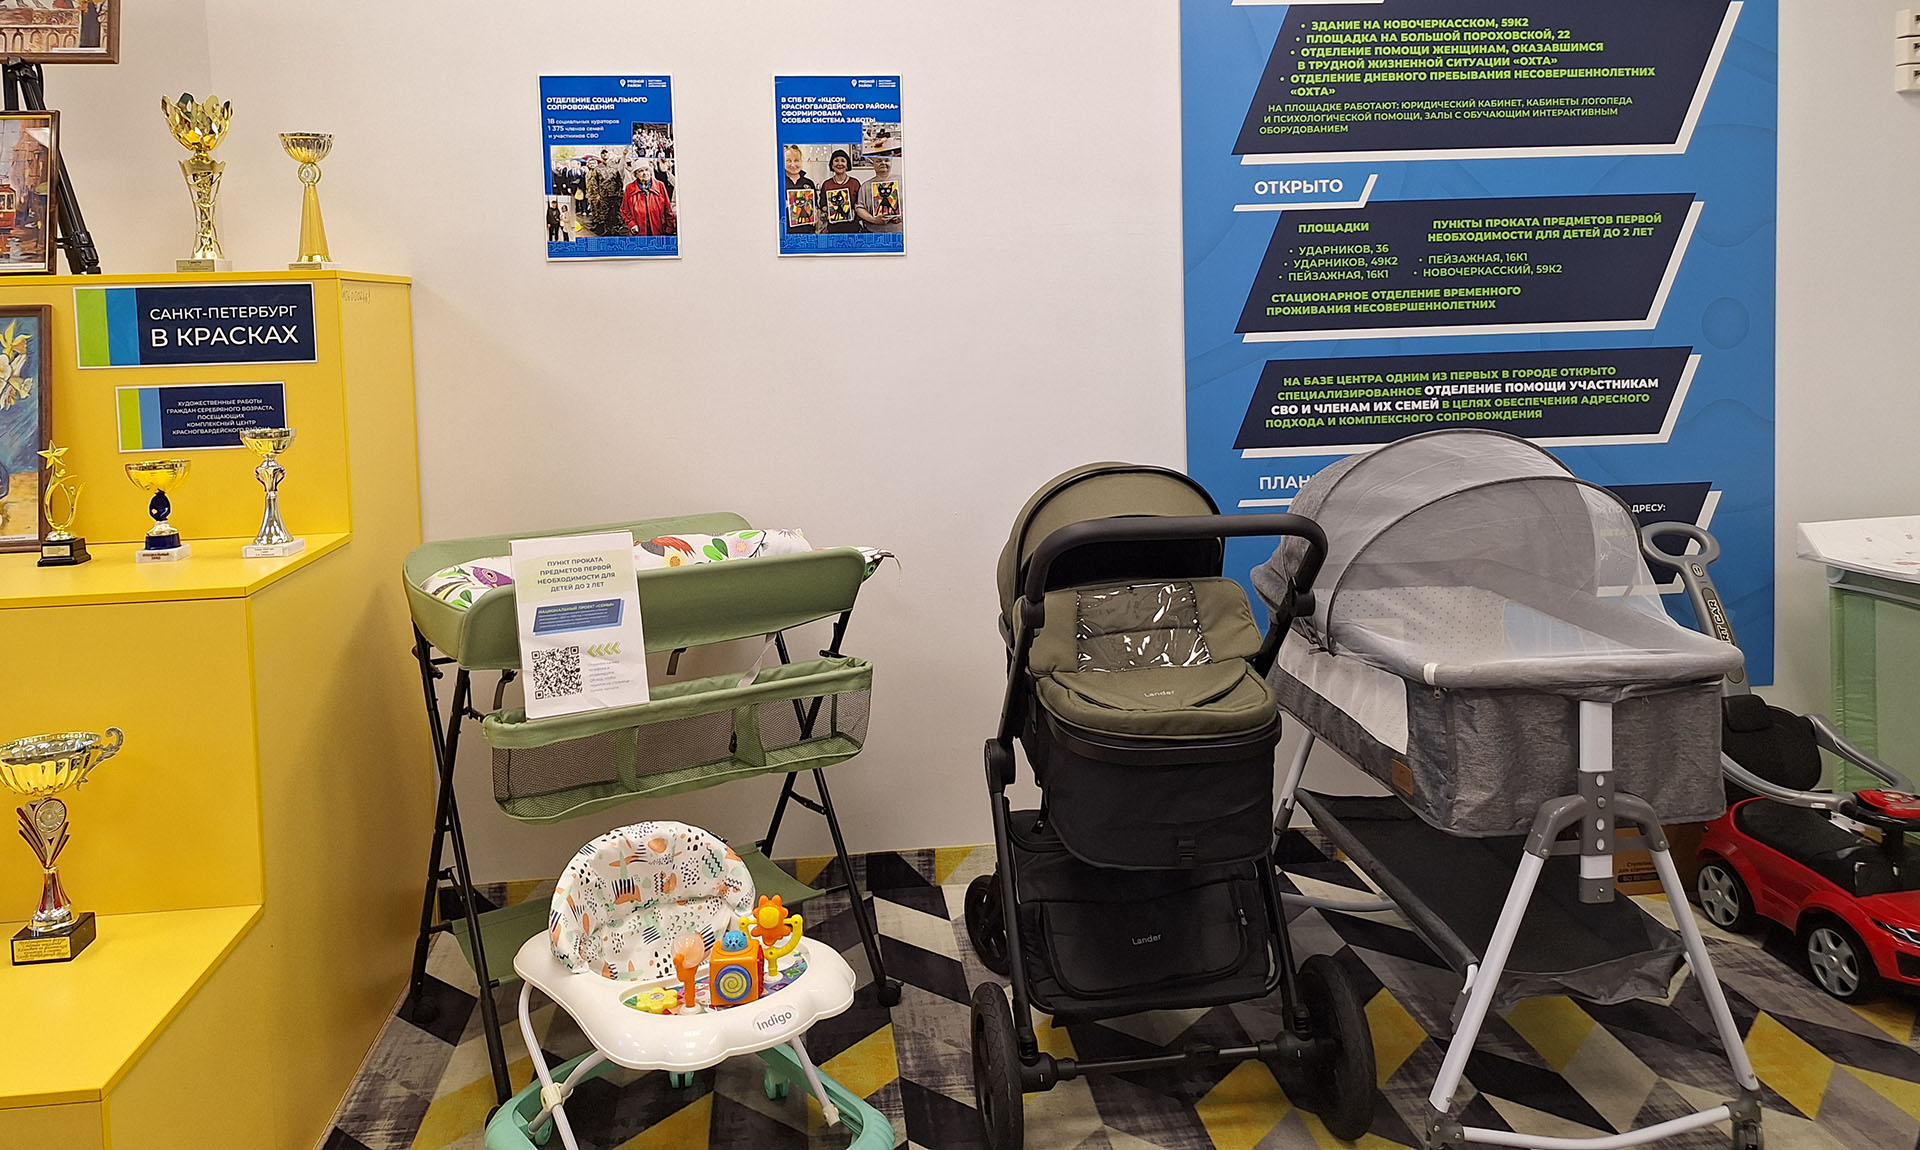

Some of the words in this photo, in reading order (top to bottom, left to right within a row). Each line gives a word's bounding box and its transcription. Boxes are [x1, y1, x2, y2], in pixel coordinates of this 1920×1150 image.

[1311, 21, 1360, 31] ЗДАНИЕ
[1363, 21, 1380, 30] НА
[1383, 19, 1498, 29] НОВОЧЕРКАССКОМ,
[1501, 18, 1529, 27] 59К2
[1306, 33, 1377, 44] ПЛОЩАДКА
[1381, 33, 1398, 42] НА
[1400, 31, 1460, 42] БОЛЬШОЙ
[1464, 28, 1555, 42] ПОРОХОВСКОЙ,
[1557, 30, 1570, 39] 22
[1301, 46, 1371, 57] ОТДЕЛЕНИЕ
[1374, 45, 1429, 56] ПОМОЩИ
[1432, 44, 1509, 55] ЖЕНЩИНАМ,
[1512, 42, 1604, 53] ОКАЗАВШИМСЯ
[1298, 61, 1305, 70] В
[1308, 58, 1364, 70] ТРУДНОЙ
[1367, 56, 1443, 69] ЖИЗНЕННОЙ
[1446, 57, 1510, 67] СИТУАЦИИ
[1513, 56, 1558, 66] «ОХТА»
[1290, 73, 1360, 84] ОТДЕЛЕНИЕ
[1363, 71, 1427, 83] ДНЕВНОГО
[1430, 71, 1511, 81] ПРЕБЫВАНИЯ
[1514, 67, 1655, 79] НЕСОВЕРШЕННОЛЕТНИХ
[1291, 87, 1336, 96] «ОХТА»
[1268, 104, 1282, 112] НА
[1284, 102, 1342, 113] ПЛОЩАДКЕ
[1344, 101, 1399, 111] РАБОТАЮТ:
[1401, 99, 1475, 110] ЮРИДИЧЕСКИЙ
[1478, 99, 1525, 108] КАБИНЕТ,
[1526, 97, 1579, 107] КАБИНЕТЫ
[1581, 96, 1633, 106] ЛОГОПЕДА
[1264, 115, 1271, 123] И
[1274, 112, 1371, 123] ПСИХОЛОГИЧЕСКОЙ
[1374, 112, 1422, 122] ПОМОЩИ,
[1425, 111, 1453, 120] ЗАЛЫ
[1455, 111, 1461, 119] С
[1464, 109, 1530, 119] ОБУЧАЮЩИМ
[1532, 107, 1618, 117] ИНТЕРАКТИВНЫМ
[1259, 124, 1349, 135] ОБОРУДОВАНИЕМ
[1254, 179, 1344, 195] ОТКРЫТО
[1298, 222, 1369, 233] ПЛОЩАДКИ
[1433, 219, 1482, 229] ПУНКТЫ
[1485, 218, 1540, 228] ПРОКАТА
[1543, 216, 1613, 226] ПРЕДМЕТОВ
[1616, 212, 1662, 224] ПЕРВОЙ
[1427, 231, 1533, 242] НЕОБХОДИМОСТИ
[1535, 229, 1560, 240] ДЛЯ
[1563, 227, 1600, 239] ДЕТЕЙ
[1603, 228, 1620, 238] ДО
[1623, 228, 1629, 237] 2
[1632, 227, 1654, 236] ЛЕТ
[1299, 245, 1374, 256] УДАРНИКОВ,
[1375, 244, 1389, 253] 36
[1293, 258, 1368, 269] УДАРНИКОВ,
[1371, 256, 1398, 266] 49К2
[1428, 253, 1503, 264] ПЕЙЗАЖНАЯ,
[1505, 252, 1528, 261] 16К1
[1288, 270, 1364, 281] ПЕЙЗАЖНАЯ,
[1366, 269, 1389, 278] 16К1
[1423, 265, 1533, 277] НОВОЧЕРКАССКИЙ,
[1536, 264, 1562, 273] 59К2
[1271, 291, 1368, 303] СТАЦИОНАРНОЕ
[1371, 289, 1441, 300] ОТДЕЛЕНИЕ
[1444, 286, 1521, 298] ВРЕМЕННОГО
[150, 305, 297, 321] САНКТ-ПЕТЕРБУРГ
[1266, 304, 1351, 316] ПРОЖИВАНИЯ
[1354, 300, 1496, 312] НЕСОВЕРШЕННОЛЕТНИХ
[151, 329, 168, 347] В
[177, 324, 299, 347] КРАСКАХ
[1284, 377, 1300, 386] НА
[1304, 376, 1334, 385] БАЗЕ
[1336, 375, 1383, 386] ЦЕНТРА
[1385, 373, 1430, 383] ОДНИМ
[1432, 372, 1448, 381] ИЗ
[1451, 370, 1499, 381] ПЕРВЫХ
[1502, 369, 1510, 379] В
[1513, 368, 1557, 379] ГОРОДЕ
[1560, 367, 1616, 377] ОТКРЫТО
[1277, 387, 1422, 401] СПЕЦИАЛИЗИРОВАННОЕ
[1424, 383, 1501, 397] ОТДЕЛЕНИЕ
[1504, 381, 1566, 393] ПОМОЩИ
[1569, 379, 1658, 391] УЧАСТНИКАМ
[1271, 405, 1298, 416] СВО
[1301, 404, 1311, 414] И
[1314, 403, 1370, 414] ЧЛЕНАМ
[1373, 402, 1392, 412] ИХ
[1395, 397, 1439, 411] СЕМЕЙ
[1442, 401, 1449, 409] В
[1452, 398, 1491, 409] ЦЕЛЯХ
[1494, 395, 1578, 407] ОБЕСПЕЧЕНИЯ
[1581, 394, 1650, 405] АДРЕСНОГО
[186, 419, 235, 428] КОМПЛЕКСНЫЙ
[1265, 417, 1325, 428] ПОДХОДА
[1327, 417, 1336, 425] И
[1339, 413, 1434, 425] КОМПЛЕКСНОГО
[1436, 410, 1543, 421] СОПРОВОЖДЕНИЯ
[1628, 504, 1666, 513] ДРЕСУ:
[540, 567, 582, 576] ПРЕДМЕТОВ
[584, 563, 612, 571] ПЕРВОЙ
[537, 574, 600, 584] НЕОБХОДИМОСТИ
[551, 584, 573, 592] ДЕТЕЙ
[1131, 934, 1161, 945] Lander
[756, 1012, 792, 1031] Indigo
